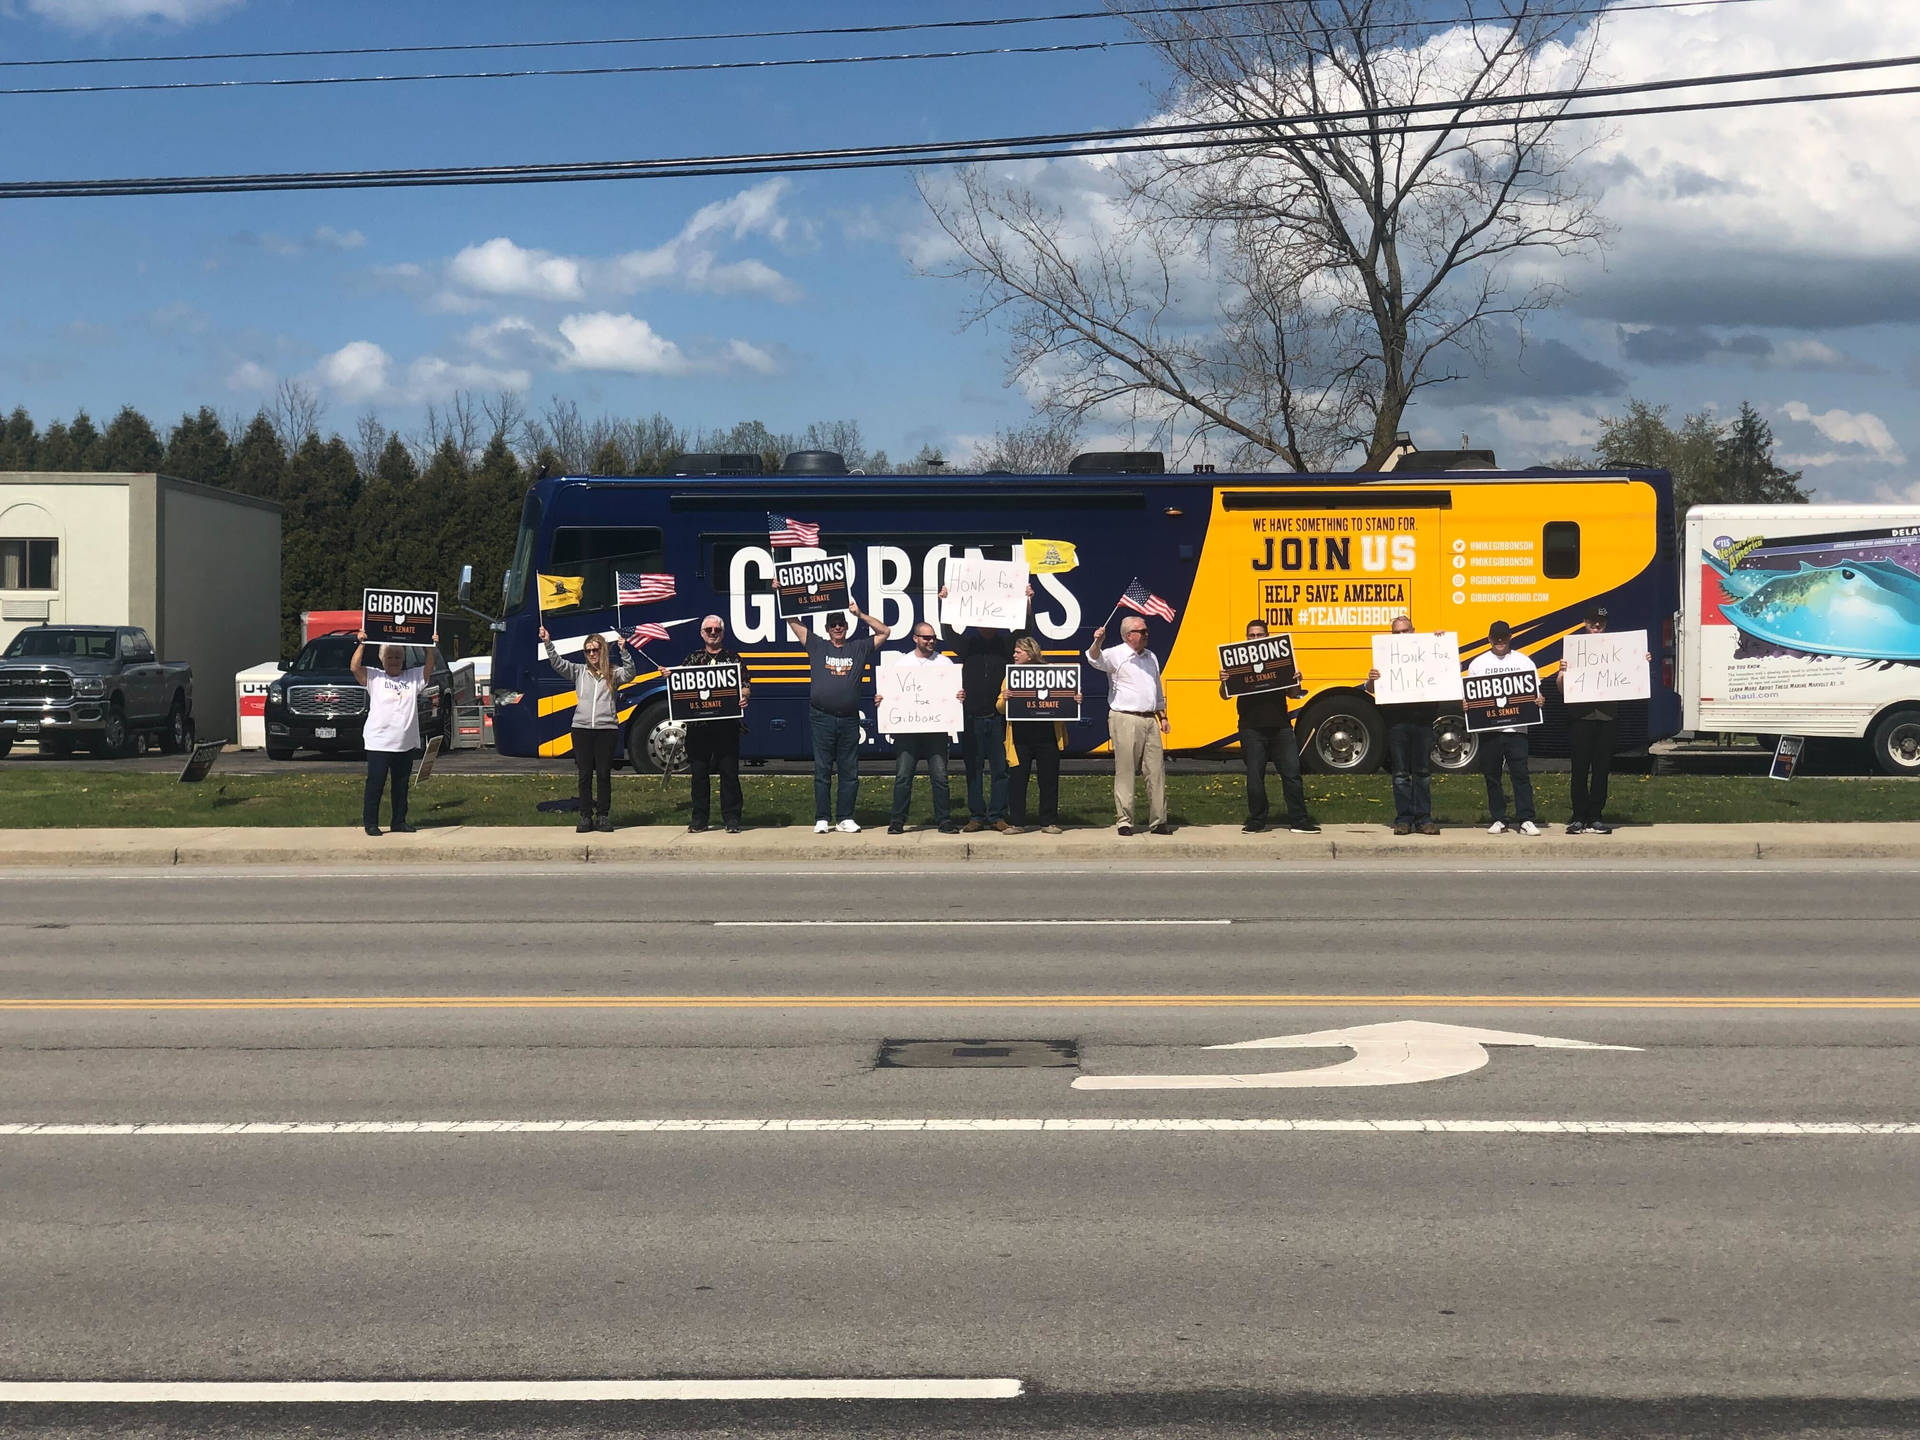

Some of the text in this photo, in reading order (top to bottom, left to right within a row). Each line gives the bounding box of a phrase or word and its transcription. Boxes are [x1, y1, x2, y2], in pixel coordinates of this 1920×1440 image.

[1253, 516, 1418, 532] WE HAVE SOMETHING TO STAND FOR.
[1252, 534, 1416, 571] JOIN US
[778, 562, 844, 587] GIBBONS
[798, 594, 830, 604] U.S. SENATE
[1265, 584, 1404, 603] HELP SAVE AMERICA
[367, 594, 434, 615] GIBBONS
[1265, 608, 1293, 625] JOIN
[383, 625, 416, 634] U.S. SENATE
[1223, 639, 1290, 667] GIBBONS
[670, 669, 737, 691] GIBBONS
[896, 671, 923, 692] Vote
[1010, 670, 1076, 688] GIBBONS
[1256, 672, 1277, 682] SENATE
[1465, 675, 1535, 700] GIBBONS
[1729, 692, 1779, 700] uhaul.com
[1499, 707, 1520, 716] SENATE
